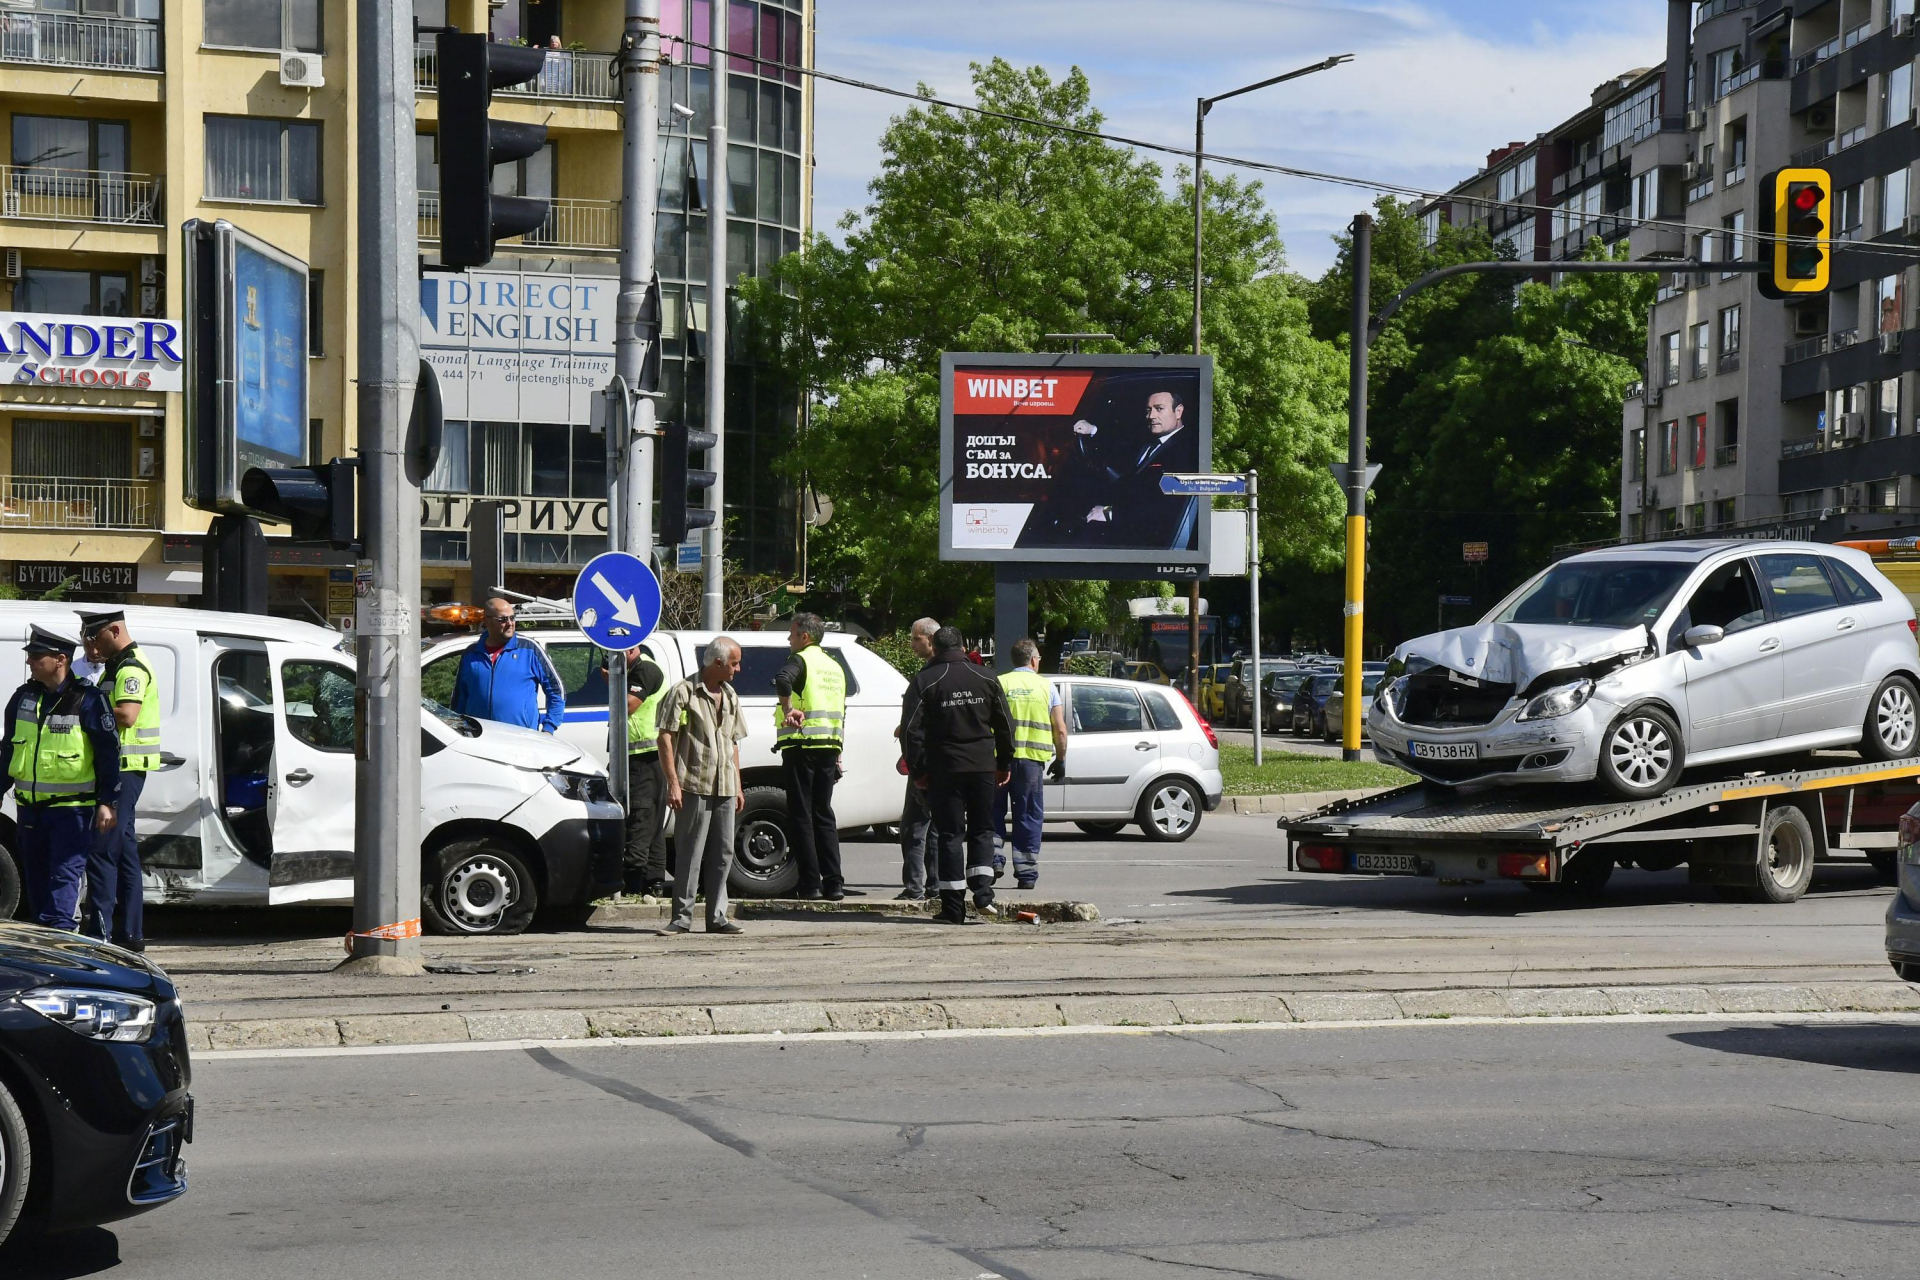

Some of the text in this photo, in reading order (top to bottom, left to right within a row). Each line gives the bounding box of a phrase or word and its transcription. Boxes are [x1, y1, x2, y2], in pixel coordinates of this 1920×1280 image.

[447, 279, 598, 311] DIRECT
[447, 311, 598, 343] ENGLISH
[477, 354, 545, 371] Language
[549, 356, 610, 374] Training
[17, 362, 152, 388] SCHOOLS
[442, 369, 484, 381] 444 71
[504, 371, 596, 388] directenglish.bg
[967, 378, 1059, 399] WINBET
[966, 435, 1017, 448] ДОШЪЛ
[965, 449, 1012, 460] СЪМ ЗА
[965, 463, 1052, 479] БОНУСА.
[968, 525, 1009, 534] winbet.bg
[18, 565, 67, 584] БУТИК
[82, 567, 133, 587] ЦВЕТЯ
[1157, 566, 1198, 574] IDEA
[941, 698, 985, 707] MUNICIPALITY
[1415, 743, 1475, 759] CB 9138 HX
[1358, 855, 1372, 869] CB
[1373, 856, 1399, 870] 2333
